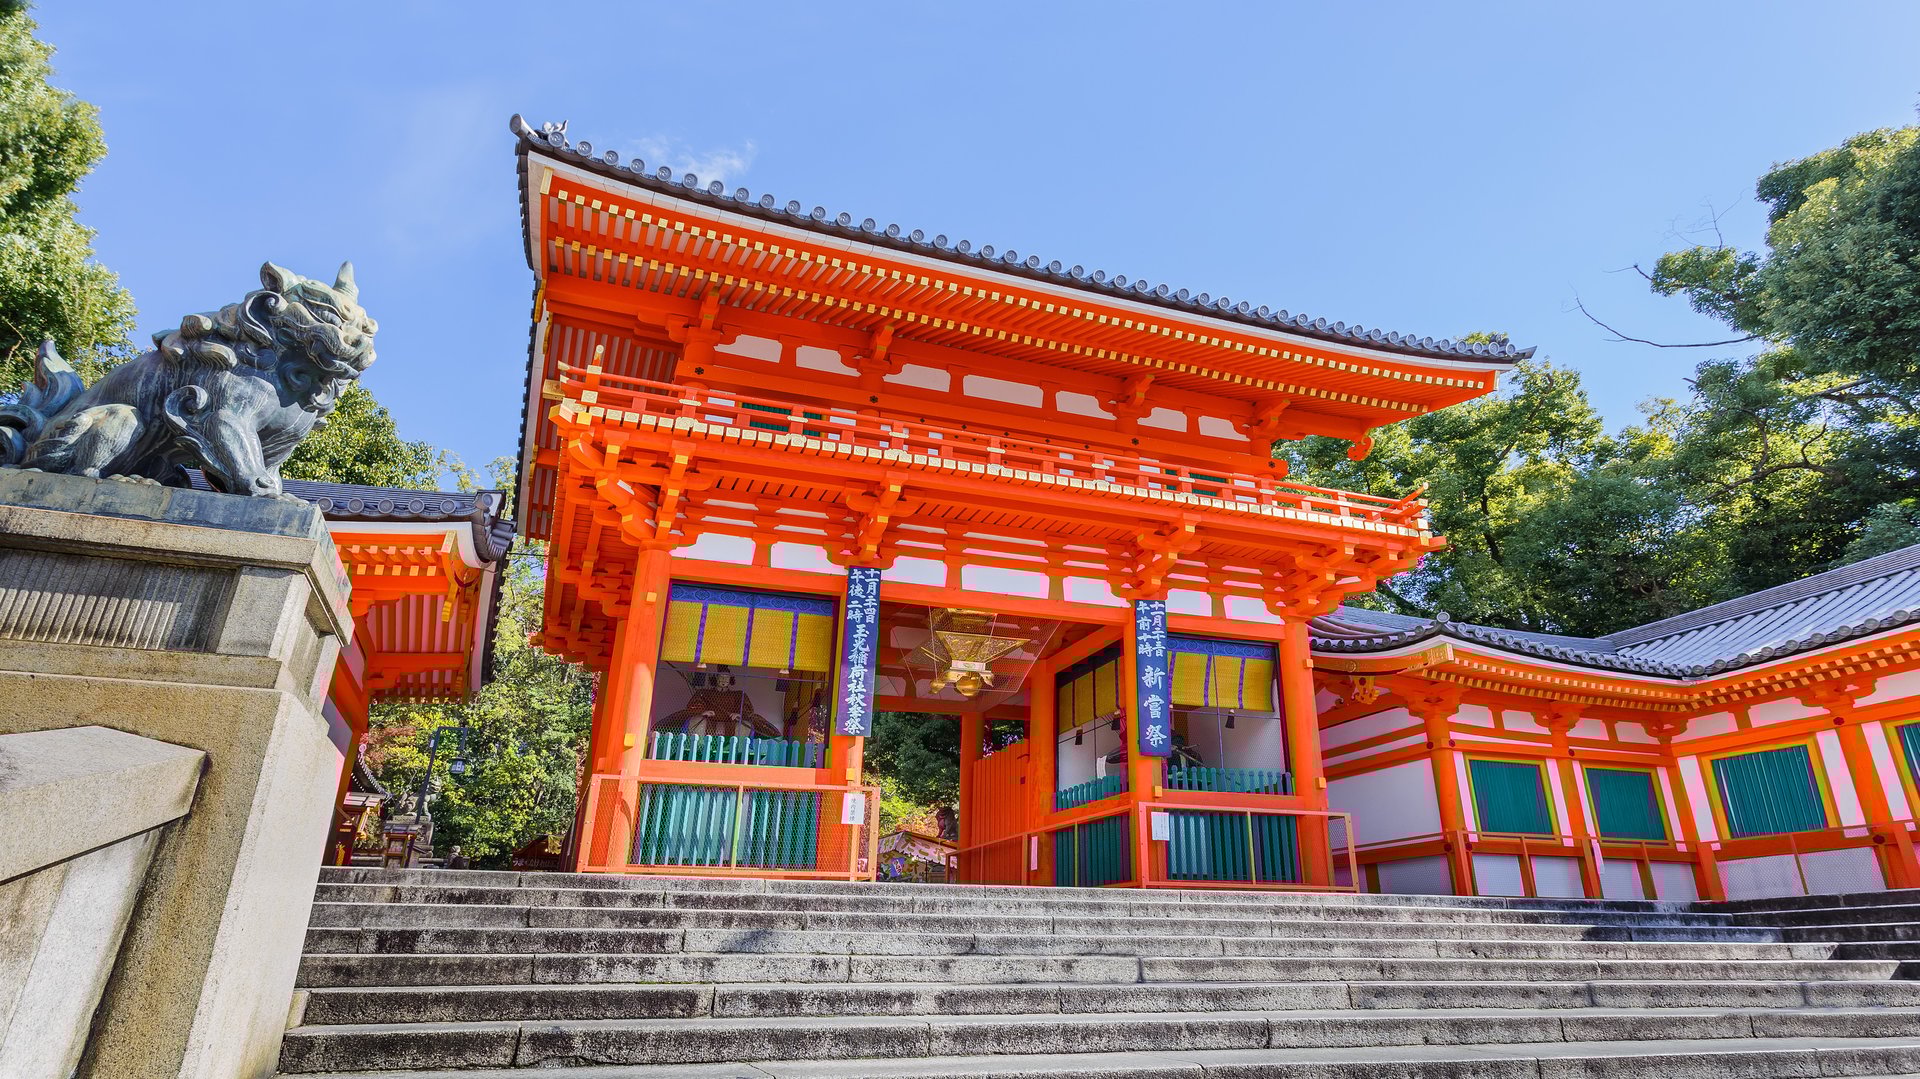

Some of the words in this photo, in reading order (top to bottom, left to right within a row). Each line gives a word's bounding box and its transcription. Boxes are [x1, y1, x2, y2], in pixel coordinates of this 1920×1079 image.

[847, 568, 866, 624] 午後二時
[1137, 600, 1153, 657] 午前十時
[1141, 665, 1167, 747] 新嘗祭
